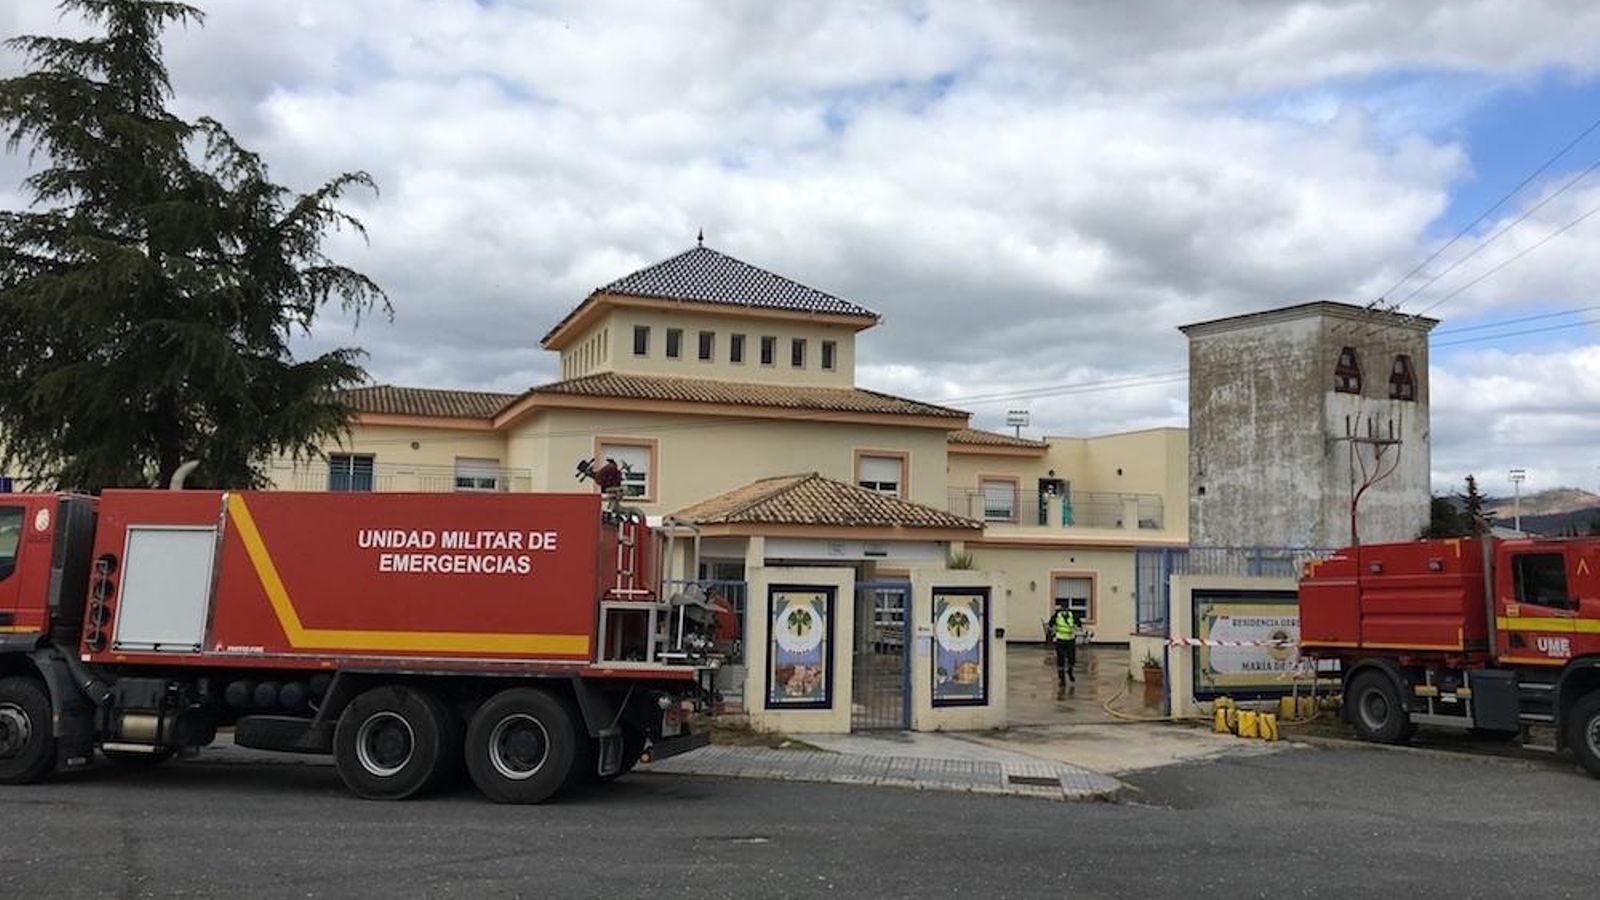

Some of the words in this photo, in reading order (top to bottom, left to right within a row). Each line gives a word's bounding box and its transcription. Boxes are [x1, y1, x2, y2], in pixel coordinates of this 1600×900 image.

[357, 530, 436, 548] UNIDAD
[441, 531, 522, 550] MILITAR
[528, 532, 558, 550] DE
[379, 554, 531, 574] EMERGENCIAS
[1537, 637, 1570, 652] UME
